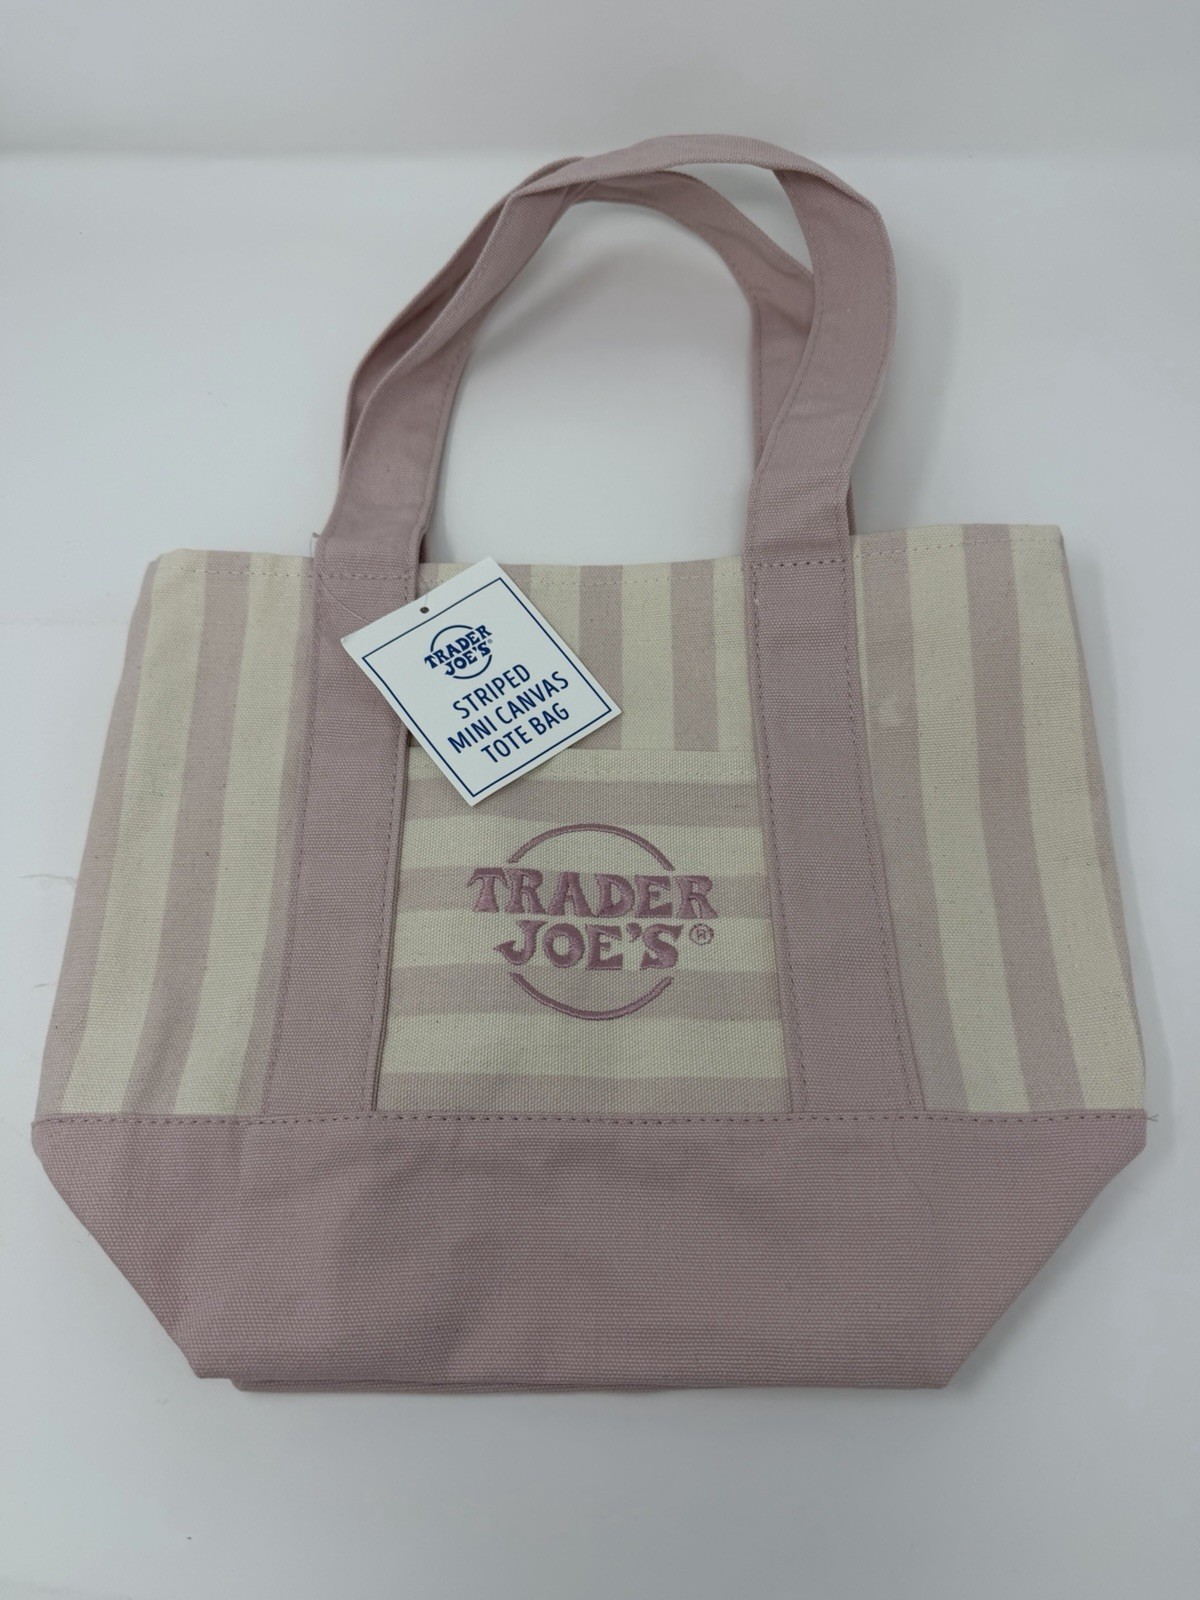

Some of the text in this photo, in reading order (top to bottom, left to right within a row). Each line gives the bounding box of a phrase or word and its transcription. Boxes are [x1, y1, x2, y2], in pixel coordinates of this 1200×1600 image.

[424, 625, 492, 669] TRADER
[447, 671, 569, 754] MINI CANVAS
[452, 664, 530, 719] STRIPED
[481, 702, 570, 763] TOTE BAG
[467, 867, 719, 919] TRADER
